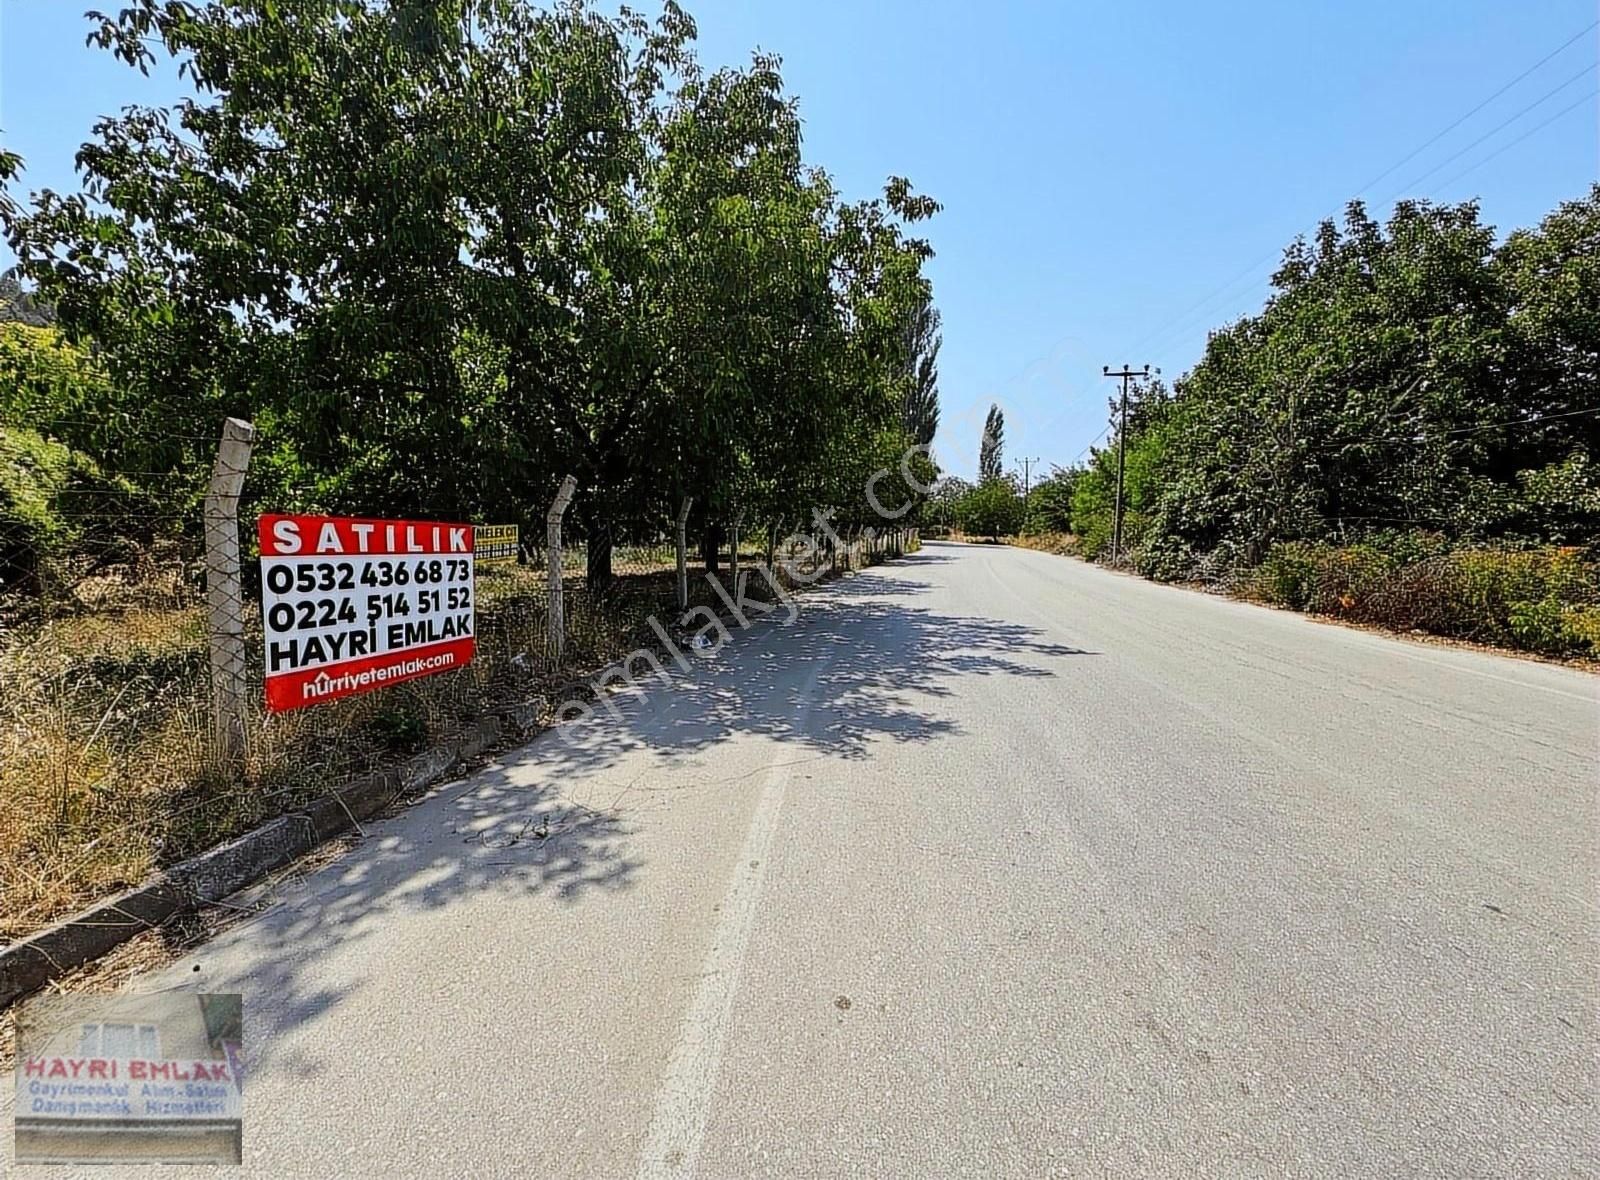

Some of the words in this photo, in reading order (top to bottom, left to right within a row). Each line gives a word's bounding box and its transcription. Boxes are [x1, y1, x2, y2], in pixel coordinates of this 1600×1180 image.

[273, 520, 467, 554] SATILIK
[267, 562, 355, 595] 0532
[360, 561, 409, 587] 436
[414, 560, 442, 583] 68
[446, 559, 469, 582] 73
[268, 597, 356, 633] 0224
[367, 595, 410, 621] 514
[418, 590, 440, 614] 51
[447, 587, 470, 610] 52
[387, 614, 471, 650] EMLAK
